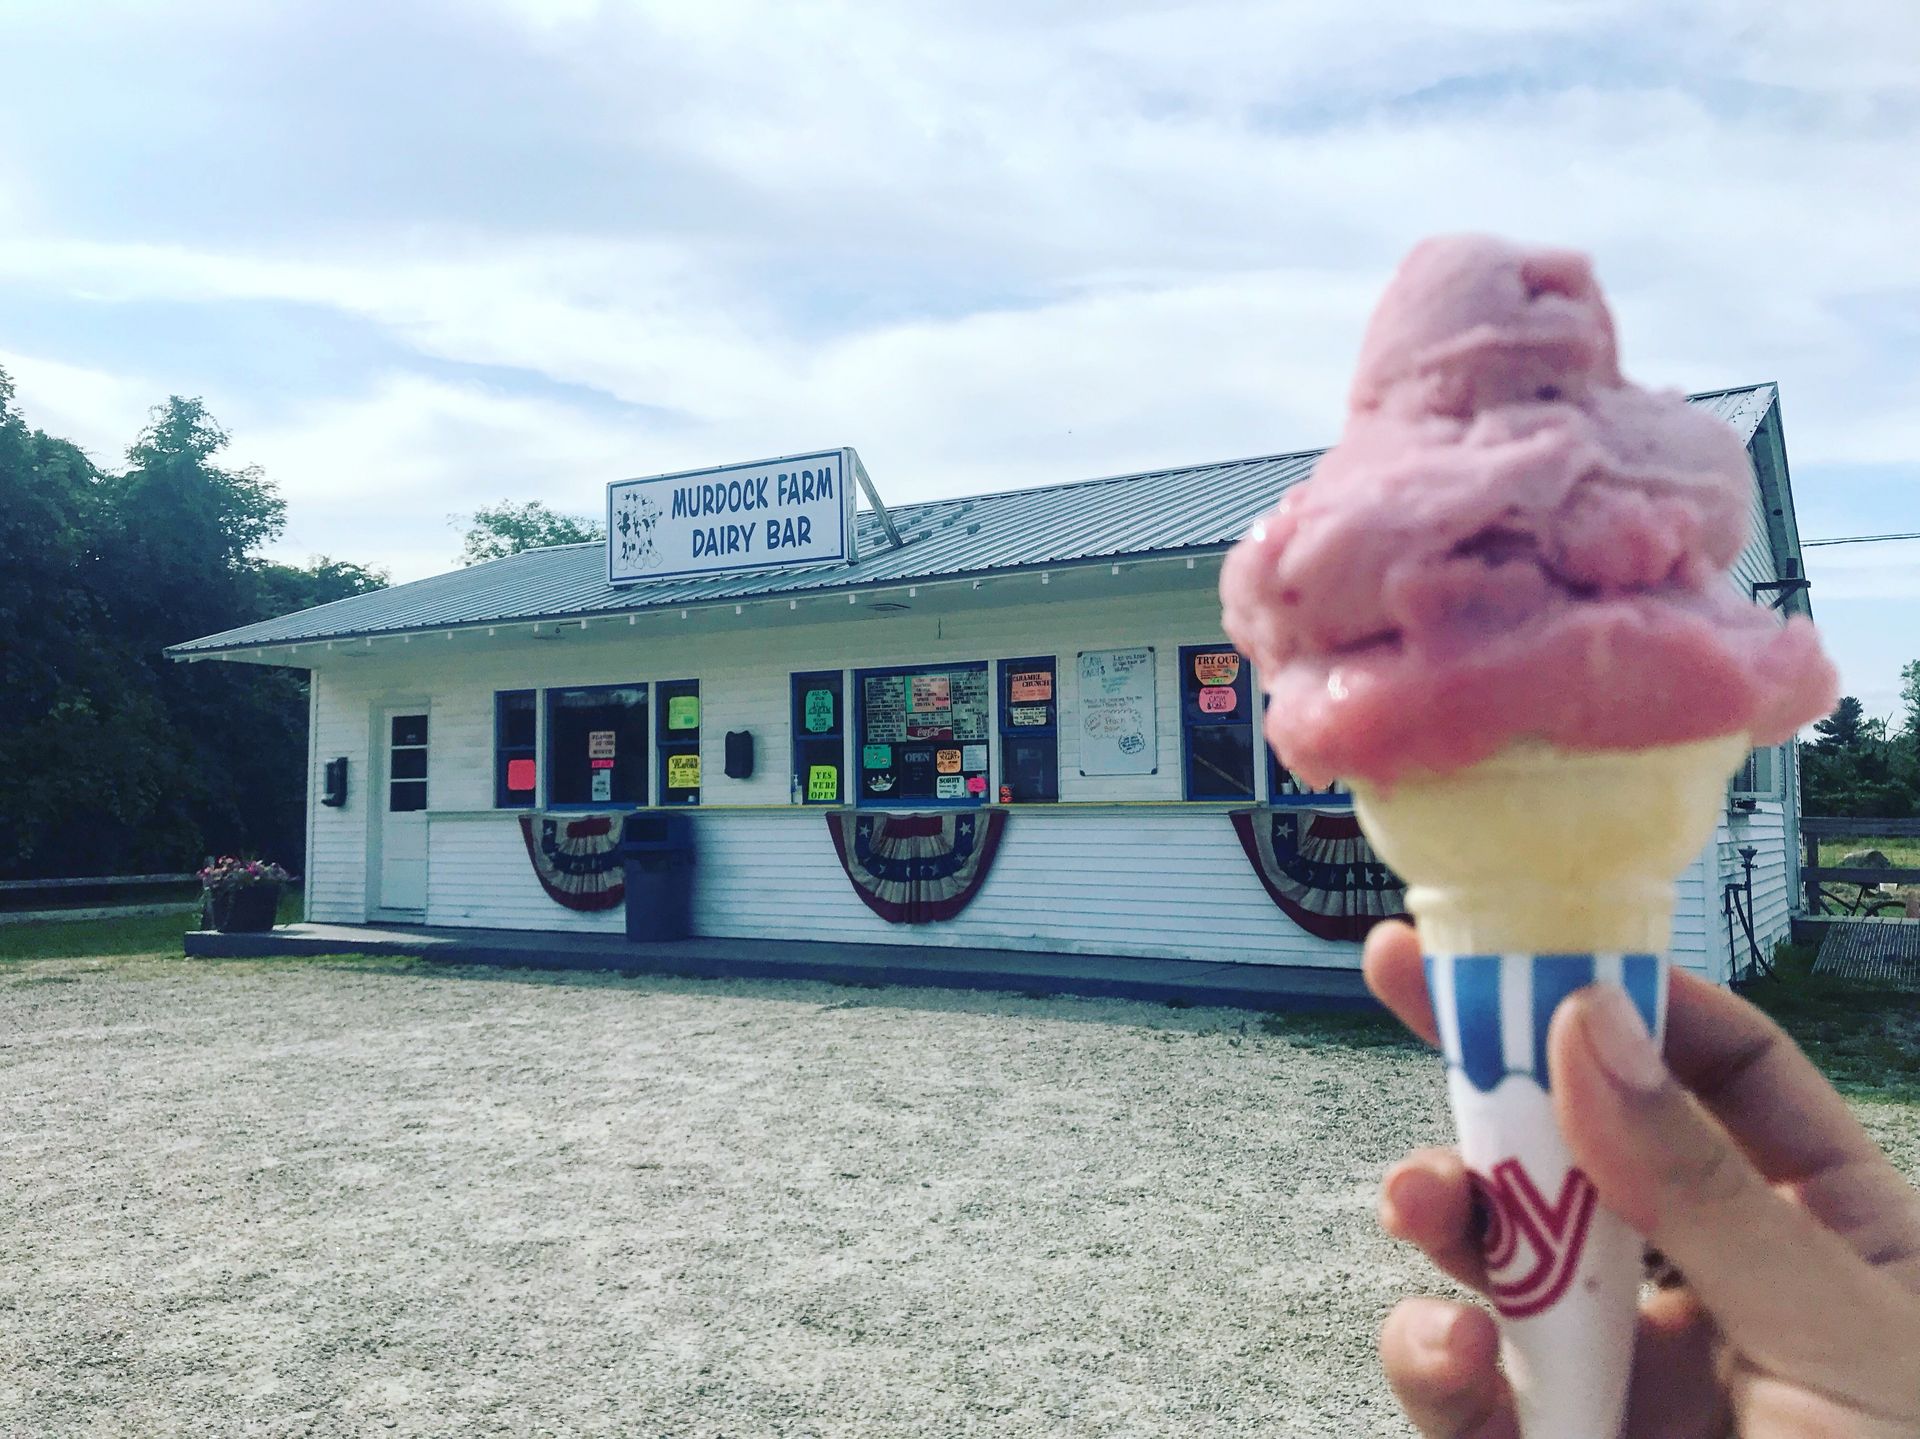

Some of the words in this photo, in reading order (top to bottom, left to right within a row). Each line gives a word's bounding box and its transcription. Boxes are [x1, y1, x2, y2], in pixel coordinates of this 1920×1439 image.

[672, 477, 768, 519] MURDOCK
[778, 467, 833, 506] FARM
[693, 522, 756, 558] DAIRY
[767, 516, 811, 549] BAR
[1197, 656, 1216, 665] TRY
[1217, 655, 1238, 664] OUR
[904, 752, 930, 762] OPEN
[816, 772, 832, 780] YES
[811, 791, 835, 799] OPEN
